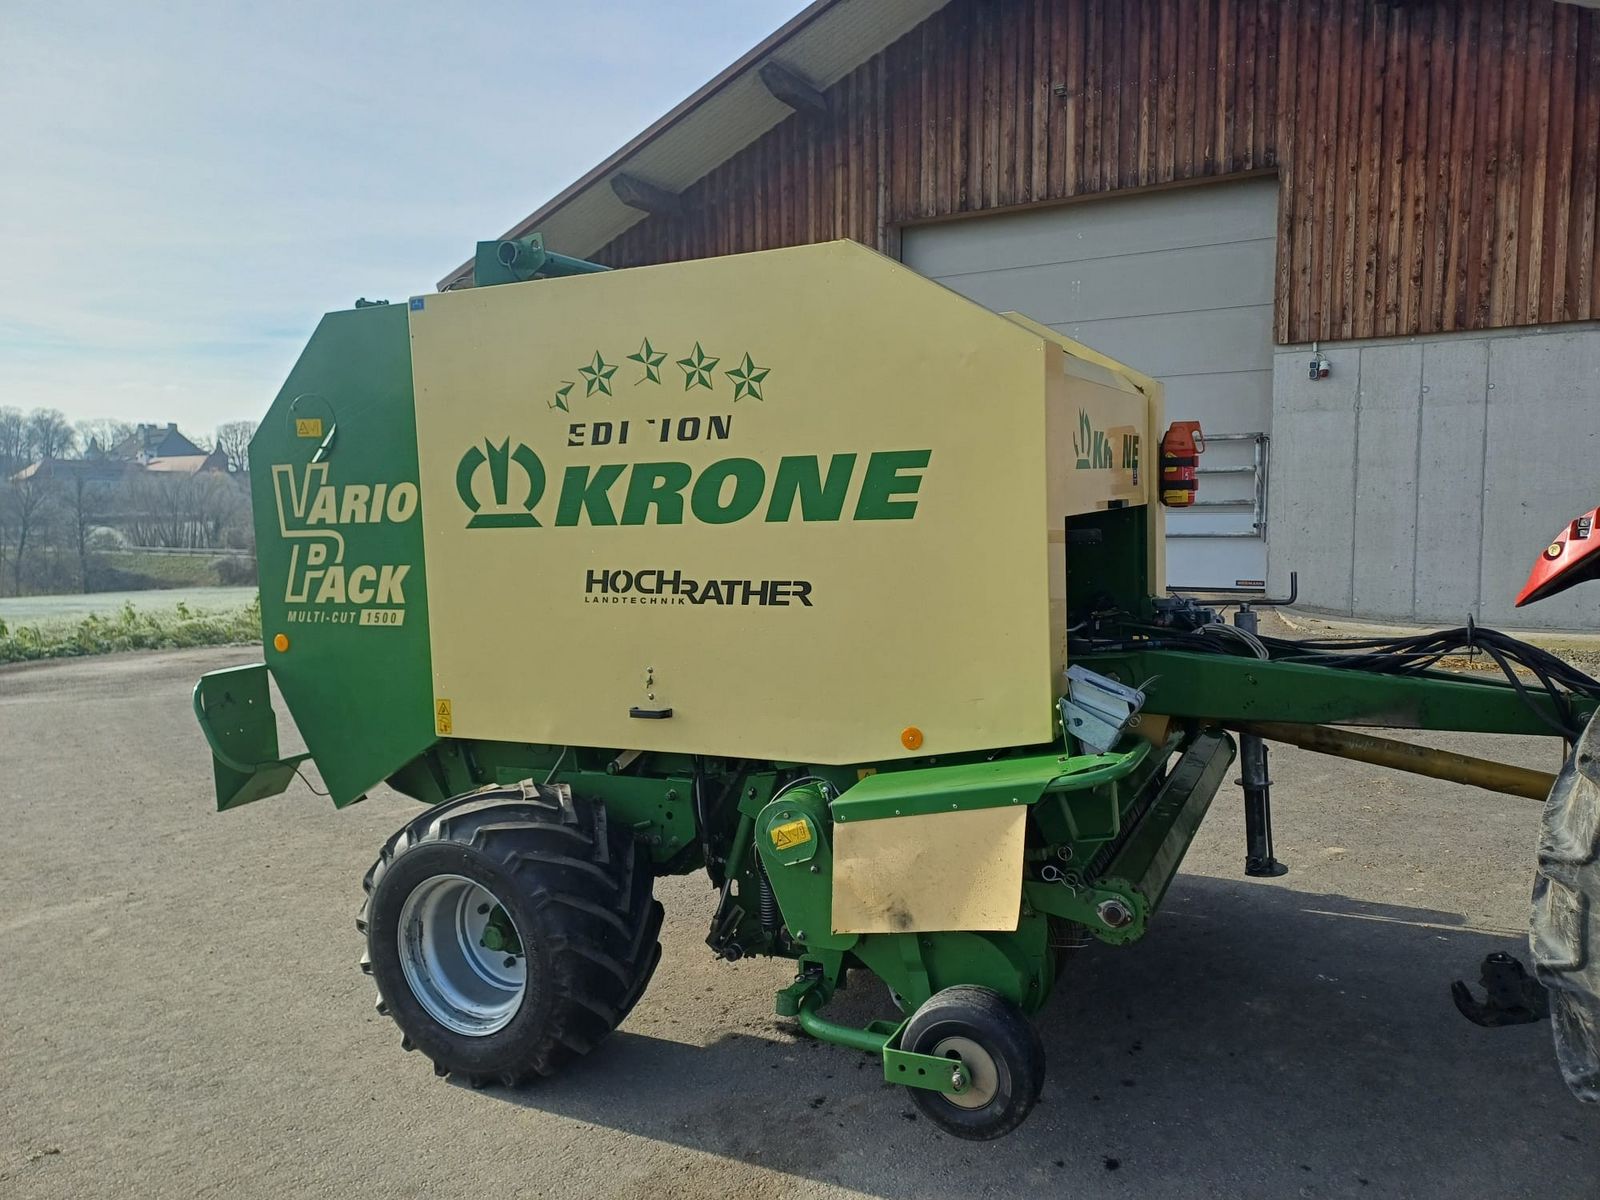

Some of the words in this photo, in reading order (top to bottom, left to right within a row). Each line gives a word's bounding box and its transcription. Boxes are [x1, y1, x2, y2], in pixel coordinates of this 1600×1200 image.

[568, 415, 732, 446] EDIION
[272, 462, 418, 524] VARIO
[555, 450, 932, 527] KRONE
[284, 530, 411, 604] PACK
[585, 570, 813, 606] HOCHRATHER
[585, 596, 685, 605] LANDTECHNIK
[287, 611, 356, 623] MULTI-CUT
[367, 612, 397, 624] 1500
